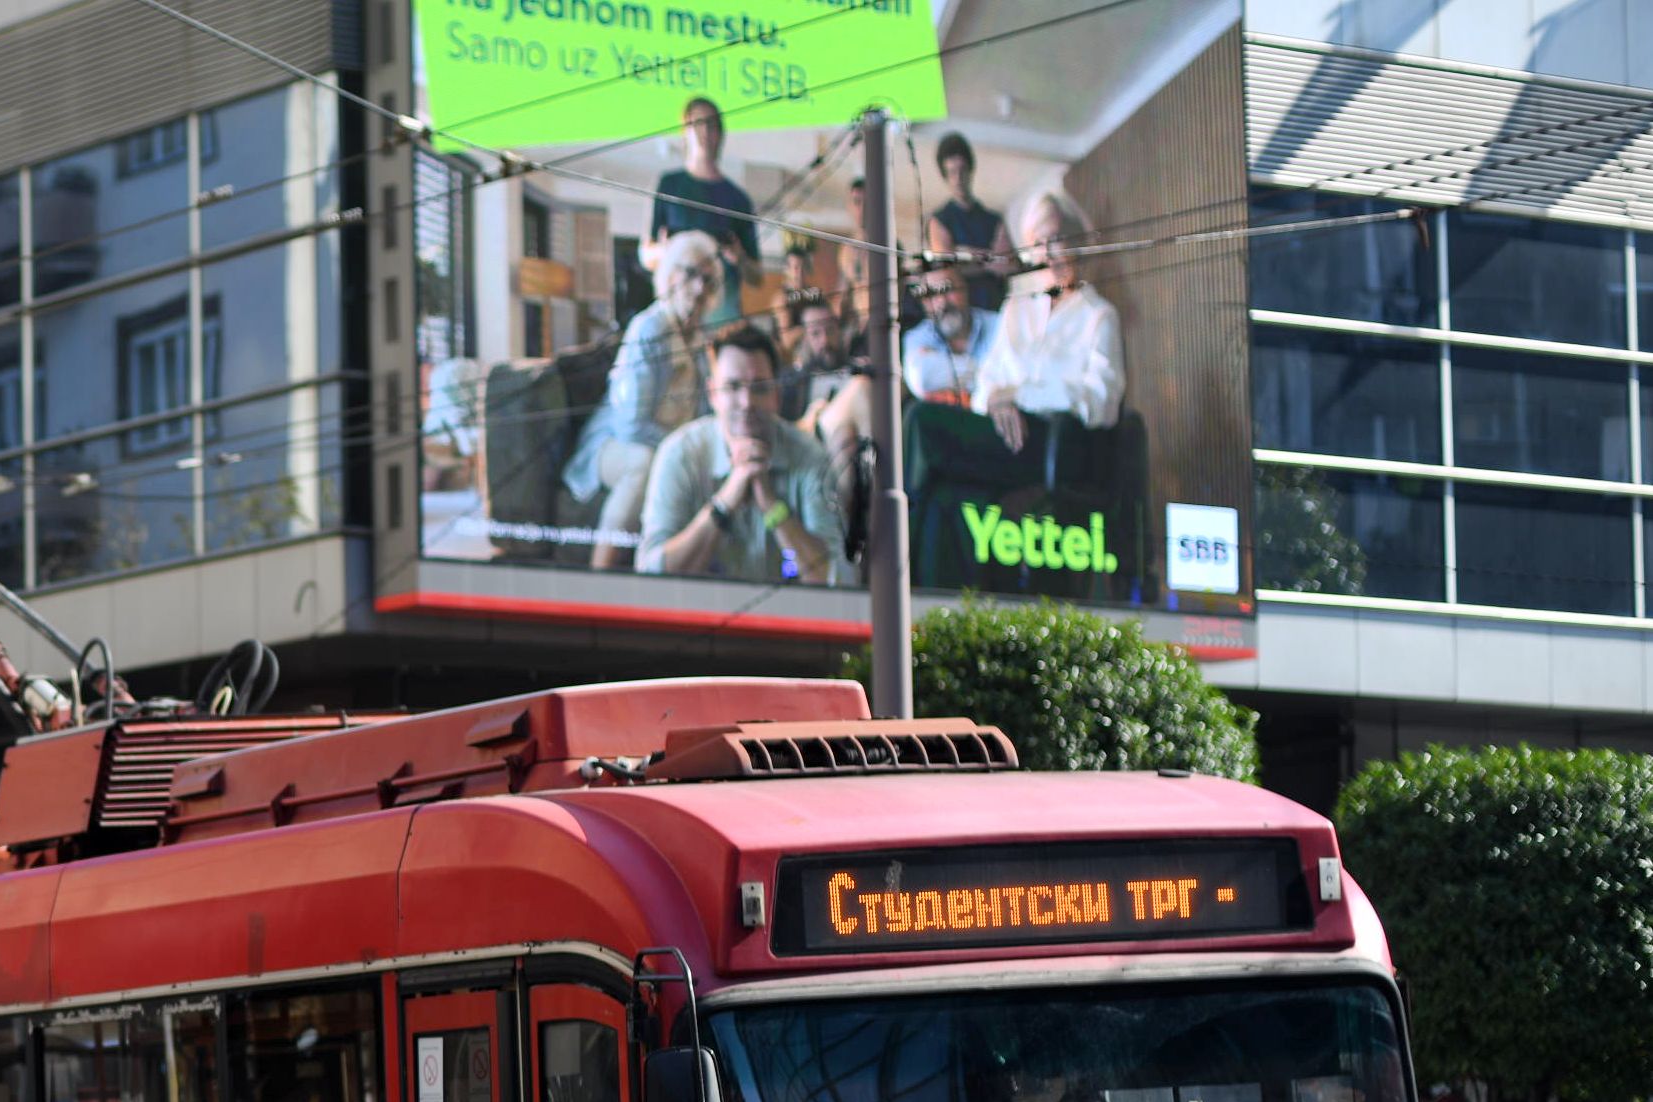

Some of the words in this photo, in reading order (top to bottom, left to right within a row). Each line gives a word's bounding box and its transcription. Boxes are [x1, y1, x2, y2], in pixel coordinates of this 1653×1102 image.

[446, 20, 549, 71] Samo
[559, 46, 600, 78] uz
[609, 42, 709, 90] Yettel
[719, 55, 728, 93] i
[665, 7, 786, 50] mestu.
[960, 502, 1118, 574] Yettel.
[1178, 534, 1230, 565] SBB
[828, 872, 1109, 936] Студентски
